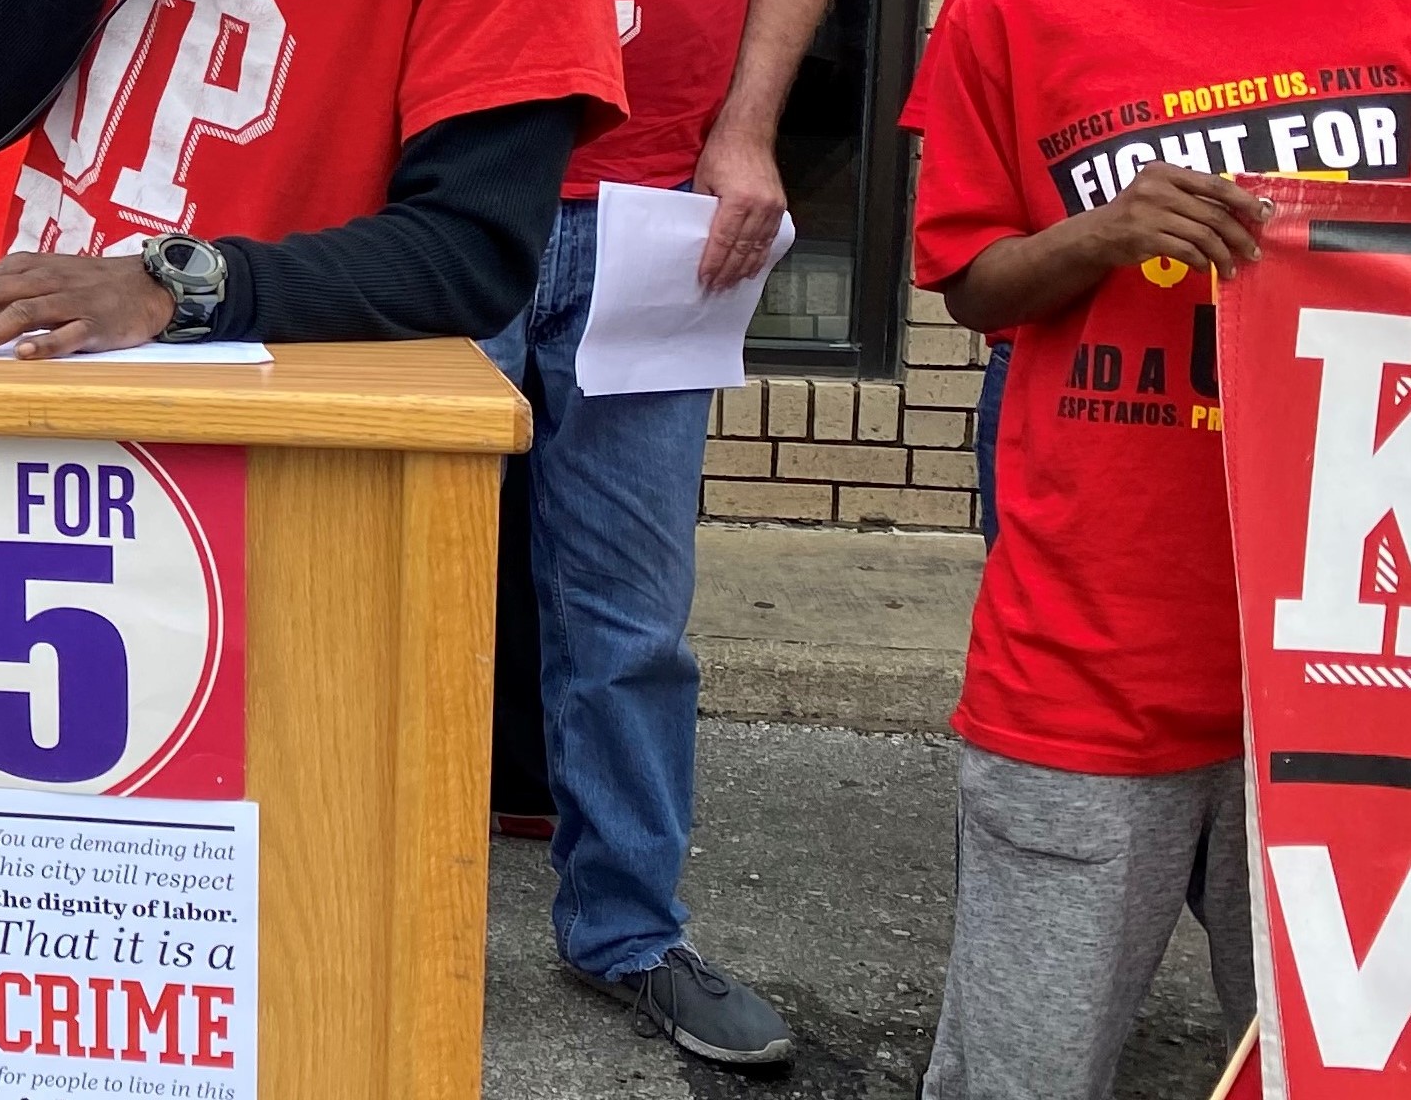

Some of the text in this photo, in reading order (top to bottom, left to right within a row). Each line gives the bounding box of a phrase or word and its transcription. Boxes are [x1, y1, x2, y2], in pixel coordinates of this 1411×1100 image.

[1037, 64, 1405, 159] RESPECT US. PROTECT US. PAY US.
[1269, 106, 1398, 173] FOR
[1066, 343, 1122, 392] ND
[1137, 347, 1166, 394] A
[1058, 396, 1184, 428] ESPETANOS.
[17, 462, 135, 540] FOR
[31, 835, 65, 850] are
[70, 833, 187, 862] demanding
[192, 840, 236, 861] that
[41, 860, 86, 886] city
[93, 863, 138, 886] will
[144, 871, 235, 894] respect
[37, 891, 127, 920] dignity
[132, 899, 159, 919] of
[163, 901, 237, 923] labor.
[113, 927, 144, 965] it
[159, 930, 195, 968] is
[208, 943, 236, 971] a
[30, 1071, 99, 1093] people
[103, 1078, 123, 1093] to
[129, 1076, 165, 1096] live
[171, 1080, 191, 1098] in
[196, 1081, 235, 1100] this
